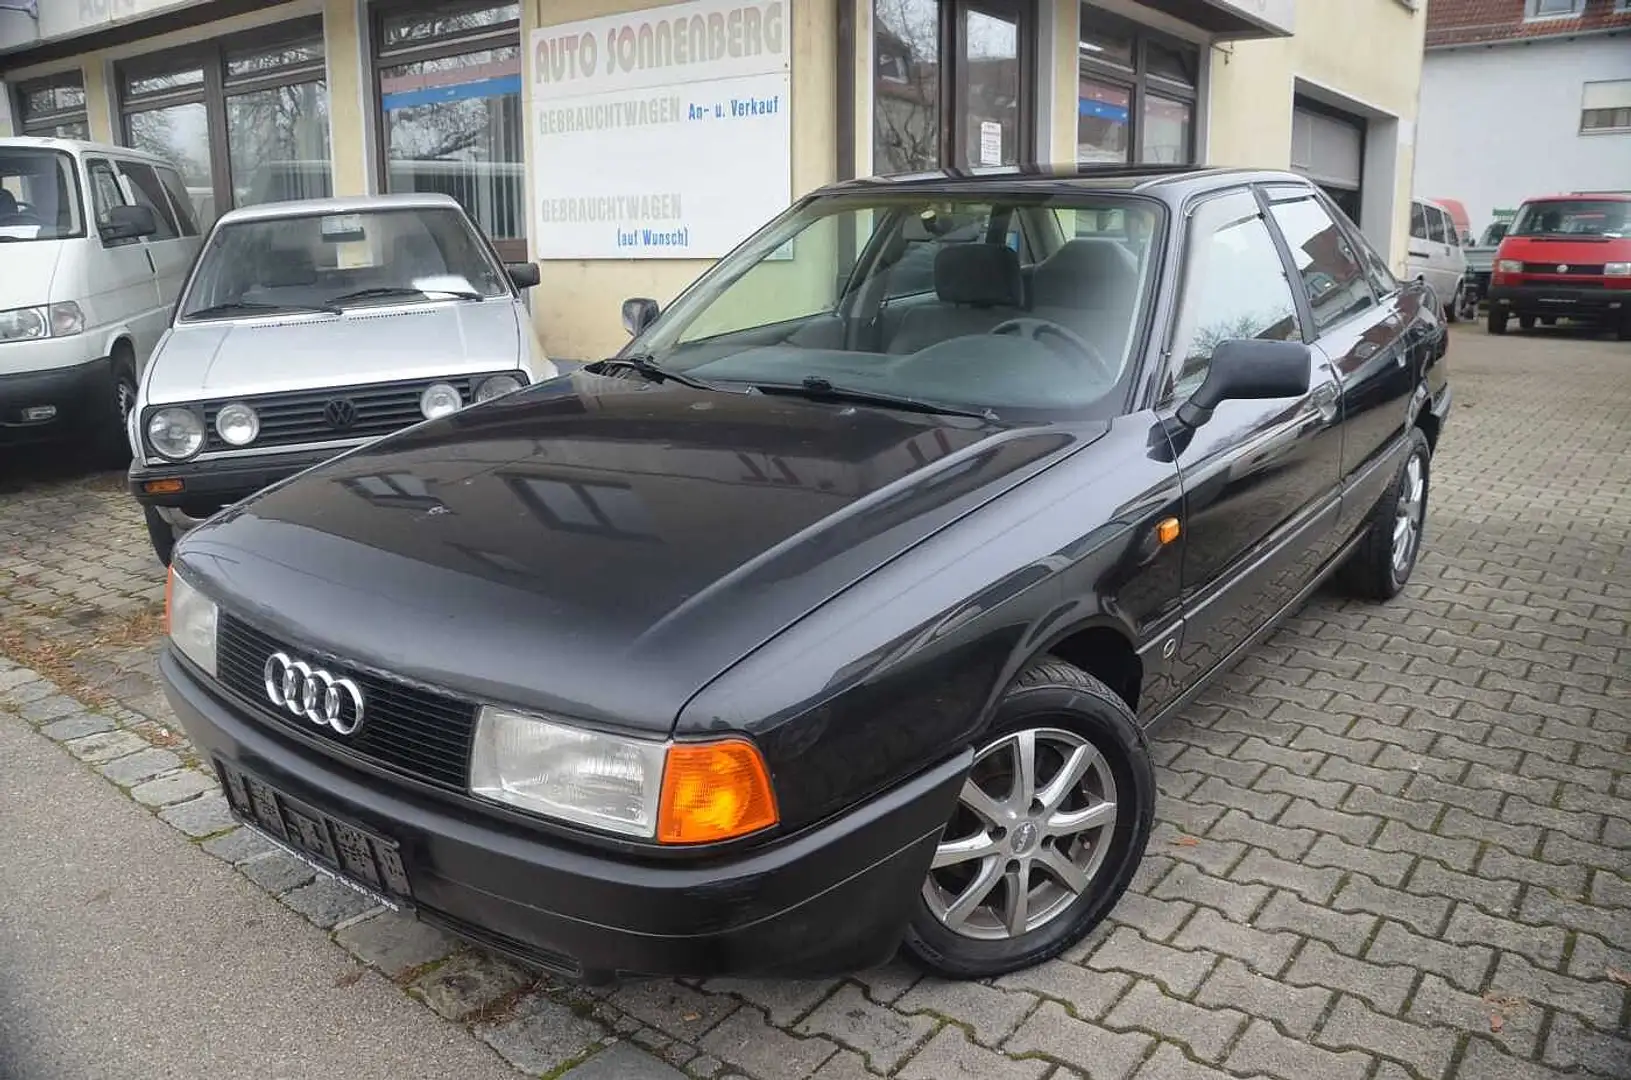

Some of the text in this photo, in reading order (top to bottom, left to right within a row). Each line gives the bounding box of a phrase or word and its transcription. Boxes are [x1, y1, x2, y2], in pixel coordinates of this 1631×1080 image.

[535, 2, 783, 84] AUTO SONNENBERG
[540, 95, 779, 134] GEBRAUCHTWAGEN An- u. Verkauf
[542, 193, 682, 222] GEBRAUCHTWAGEN
